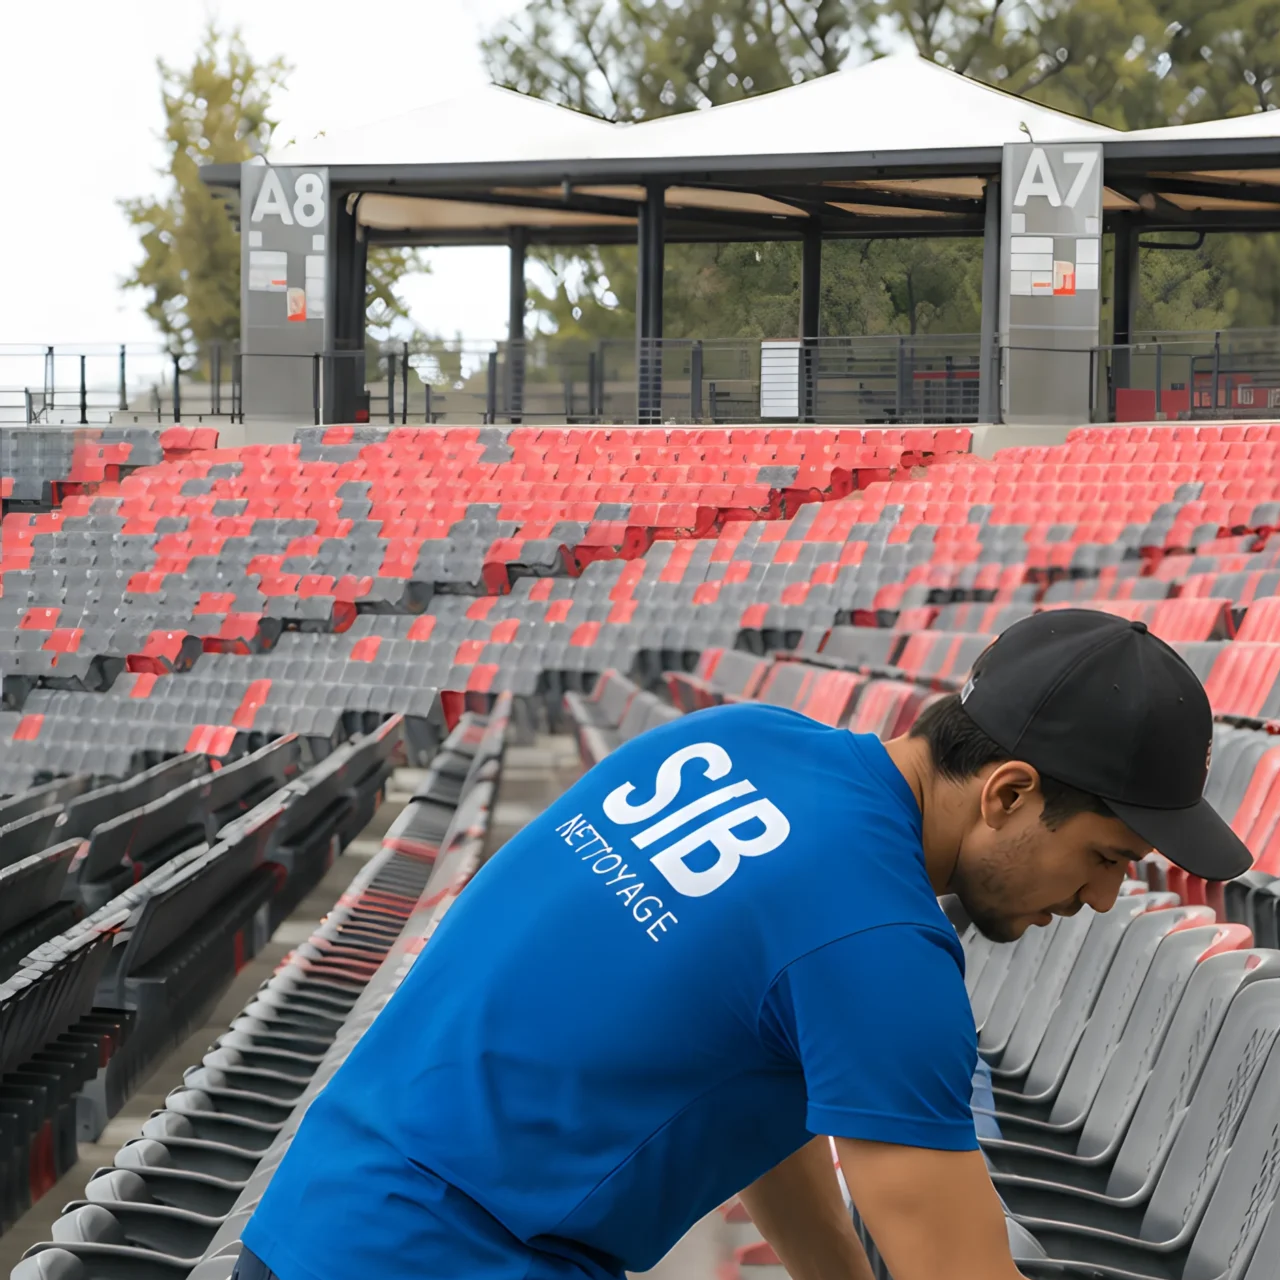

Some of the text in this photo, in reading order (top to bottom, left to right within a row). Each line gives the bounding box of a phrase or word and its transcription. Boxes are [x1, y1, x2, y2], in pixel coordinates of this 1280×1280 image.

[251, 168, 325, 228] A8
[1013, 147, 1099, 208] A7
[602, 741, 791, 897] SIB
[555, 813, 679, 942] NETTOYAGE
